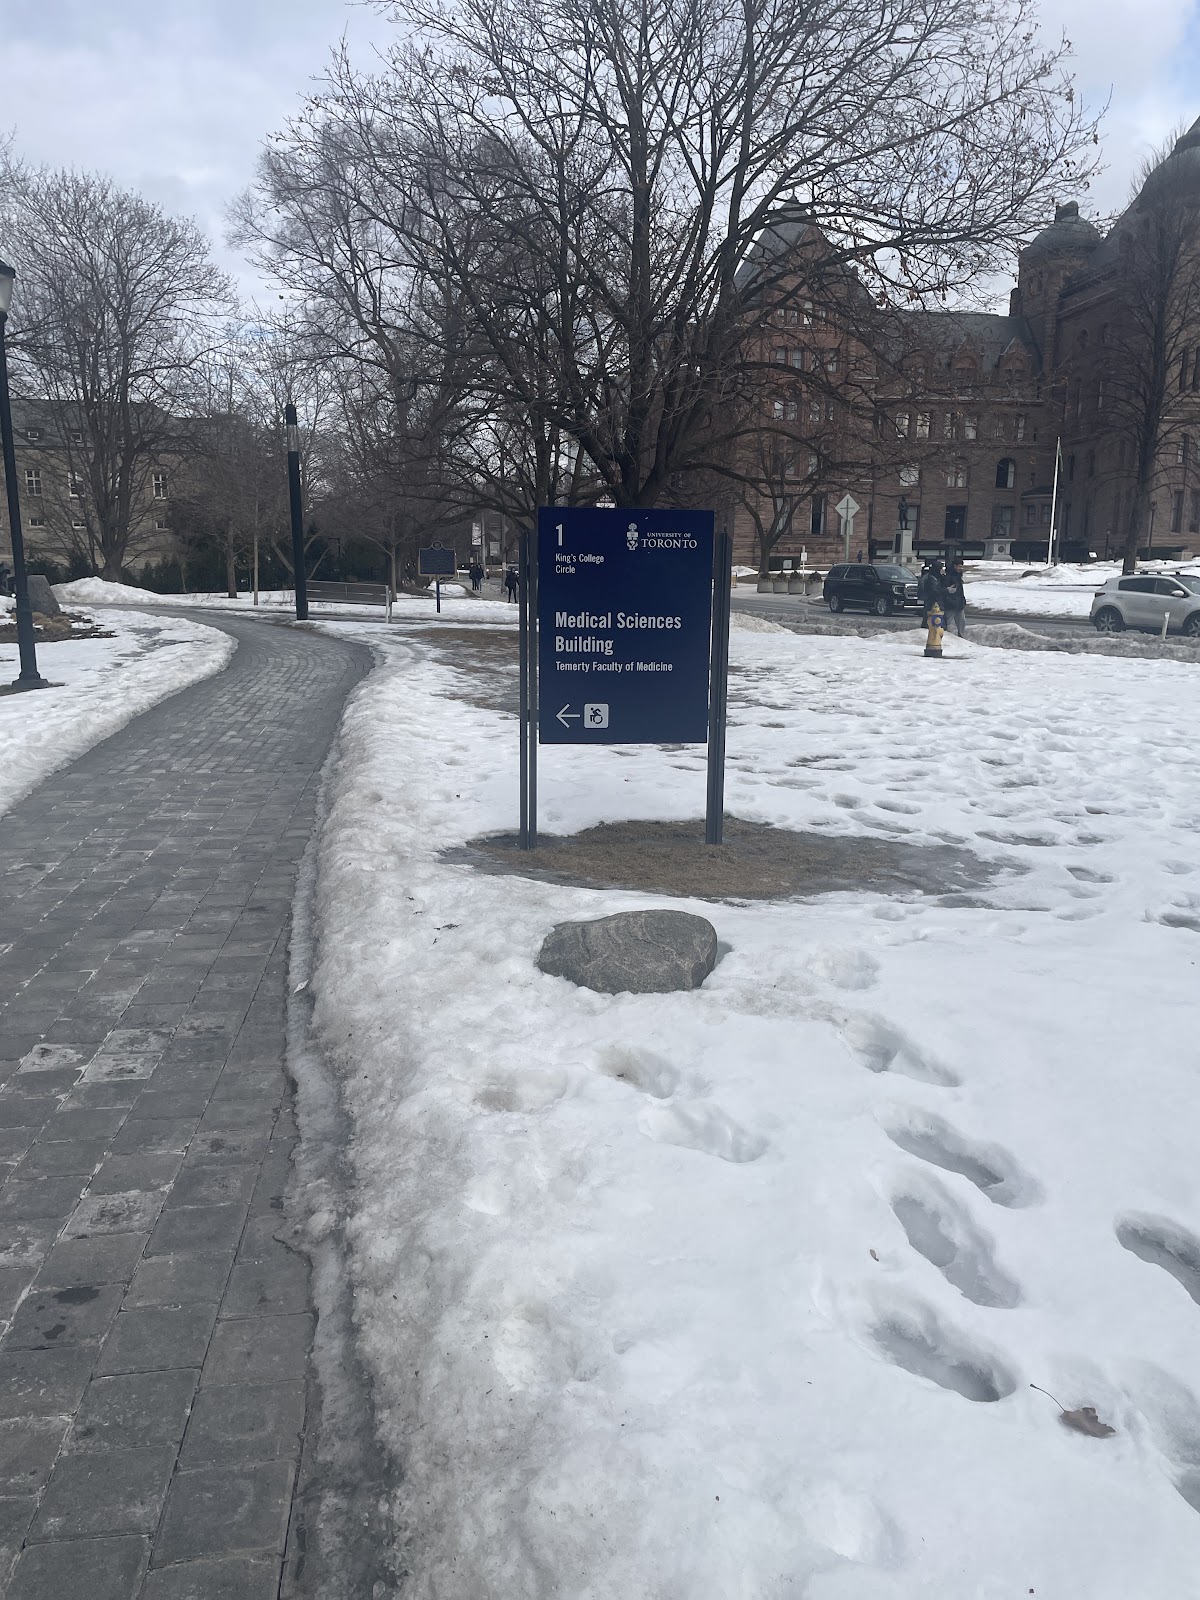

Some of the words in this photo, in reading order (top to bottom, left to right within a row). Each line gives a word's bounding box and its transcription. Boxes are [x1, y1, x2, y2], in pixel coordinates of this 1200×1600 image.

[555, 524, 563, 546] 1
[641, 539, 697, 549] TORONTO
[555, 553, 577, 564] King's
[578, 554, 604, 564] College
[555, 565, 576, 574] Circle
[555, 612, 612, 629] Medical
[617, 613, 682, 629] Sciences
[555, 636, 614, 655] Building
[556, 661, 590, 672] Temerty
[592, 662, 623, 672] Faculty
[625, 662, 634, 671] of
[636, 662, 673, 671] Medicine
